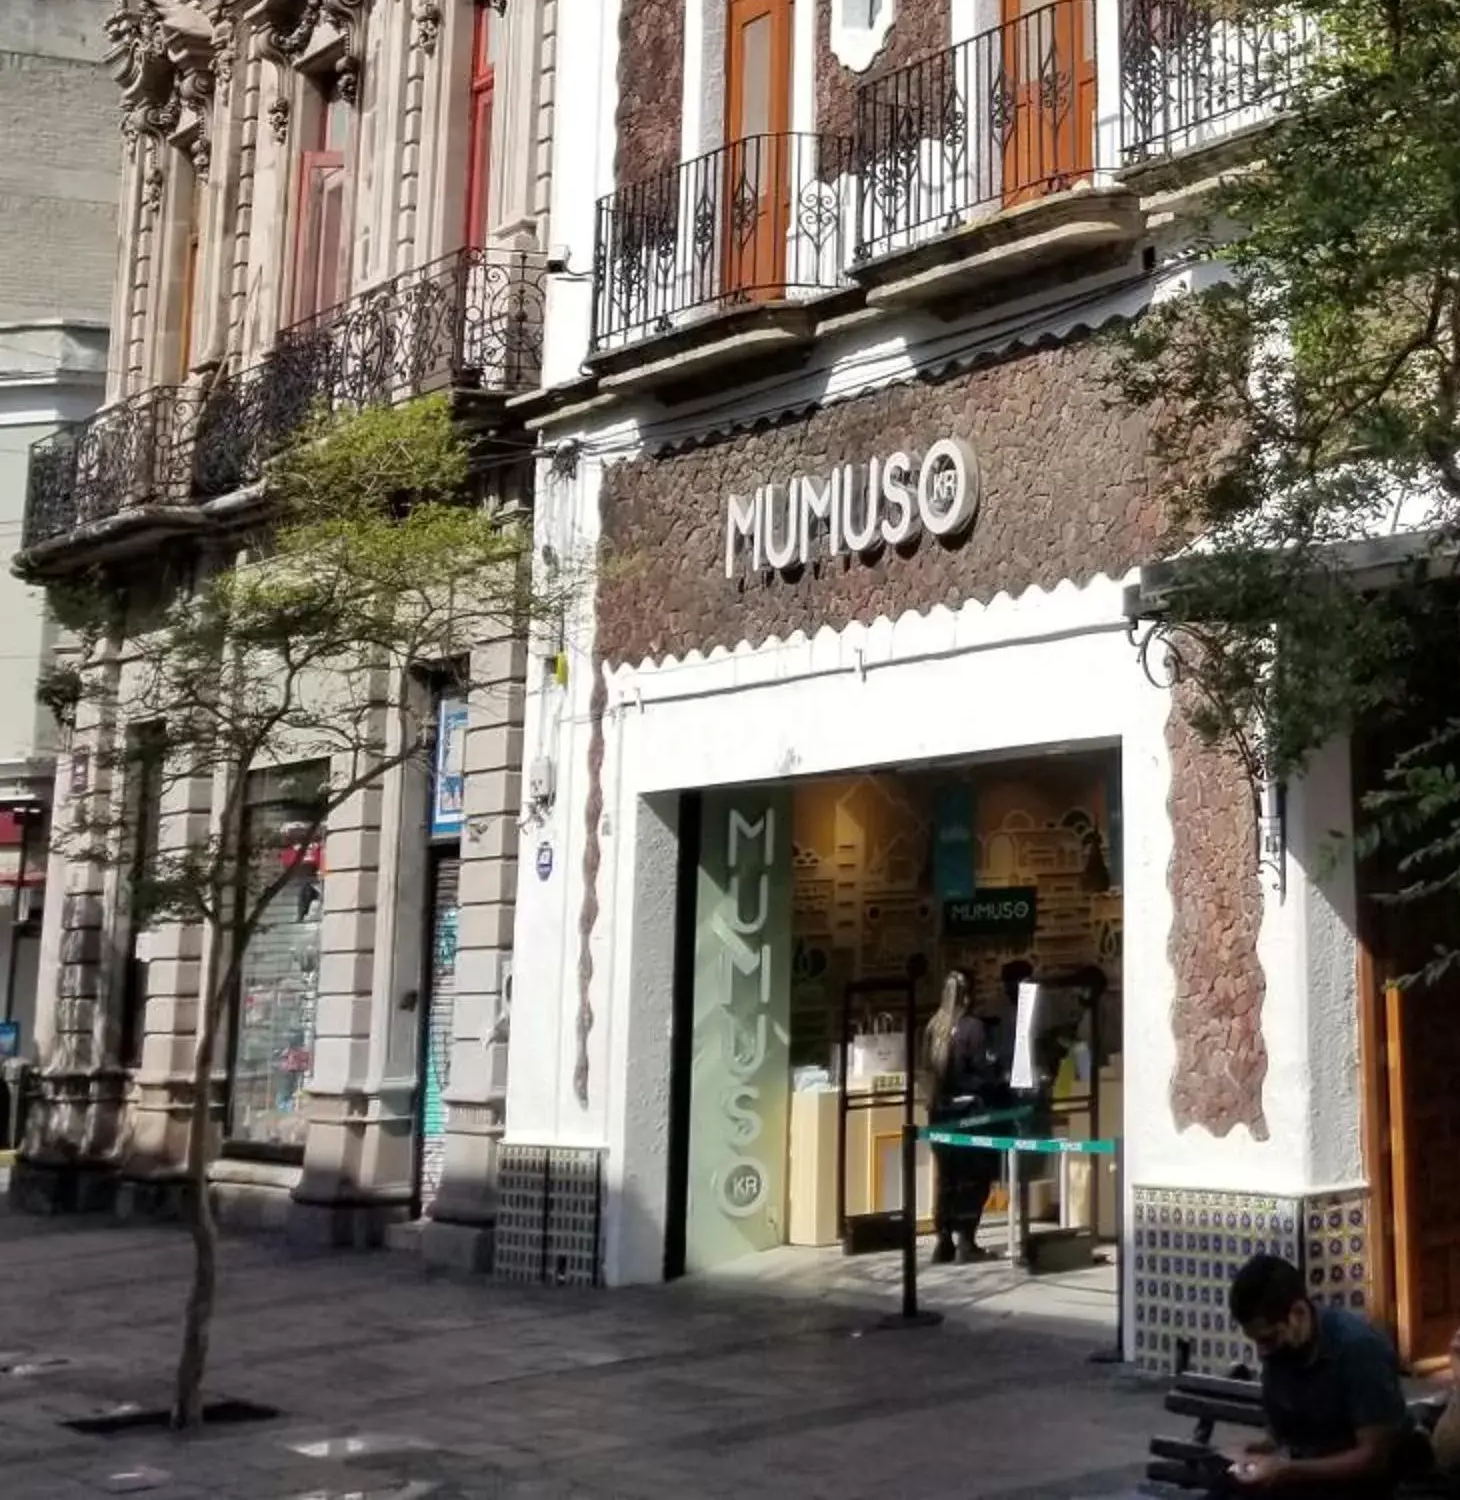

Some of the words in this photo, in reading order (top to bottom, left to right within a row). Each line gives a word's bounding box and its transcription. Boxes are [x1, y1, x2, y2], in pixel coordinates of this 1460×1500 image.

[932, 469, 957, 502] KR
[725, 438, 975, 580] MUMUSO
[950, 899, 1030, 922] MUMUSO
[717, 806, 775, 1218] MUMUSO
[732, 1174, 759, 1195] KR
